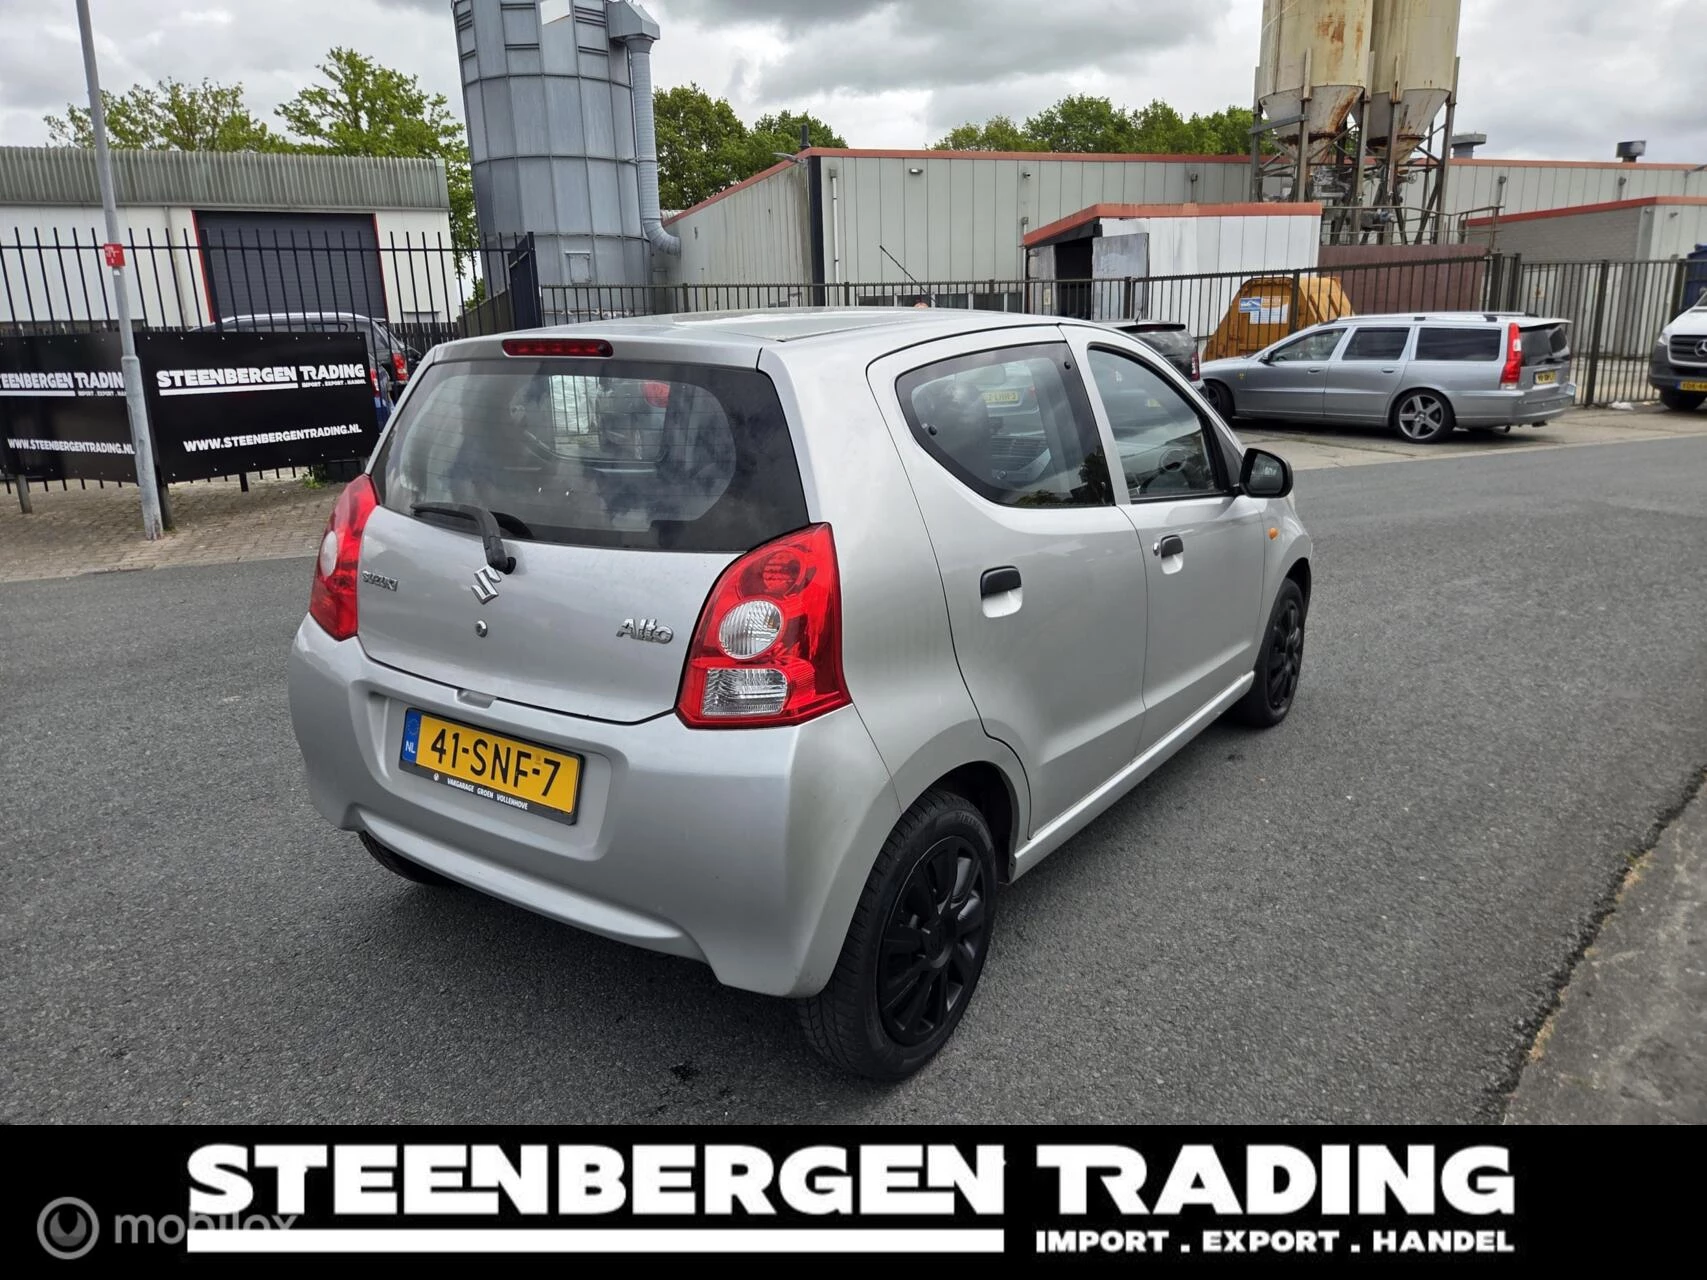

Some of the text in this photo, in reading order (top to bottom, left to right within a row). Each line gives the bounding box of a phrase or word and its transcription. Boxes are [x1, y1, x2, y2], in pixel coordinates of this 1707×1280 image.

[0, 371, 125, 389] EENBERGEN TRADIN
[156, 363, 366, 388] STEENBERGEN TRADING
[7, 438, 136, 455] WWW.STEENBERGENTRADING.NL
[183, 423, 363, 453] WWW.STEENBERGENTRADING.NL
[616, 618, 674, 645] Alto
[405, 740, 416, 754] NL
[430, 728, 561, 797] 41-SNF-7
